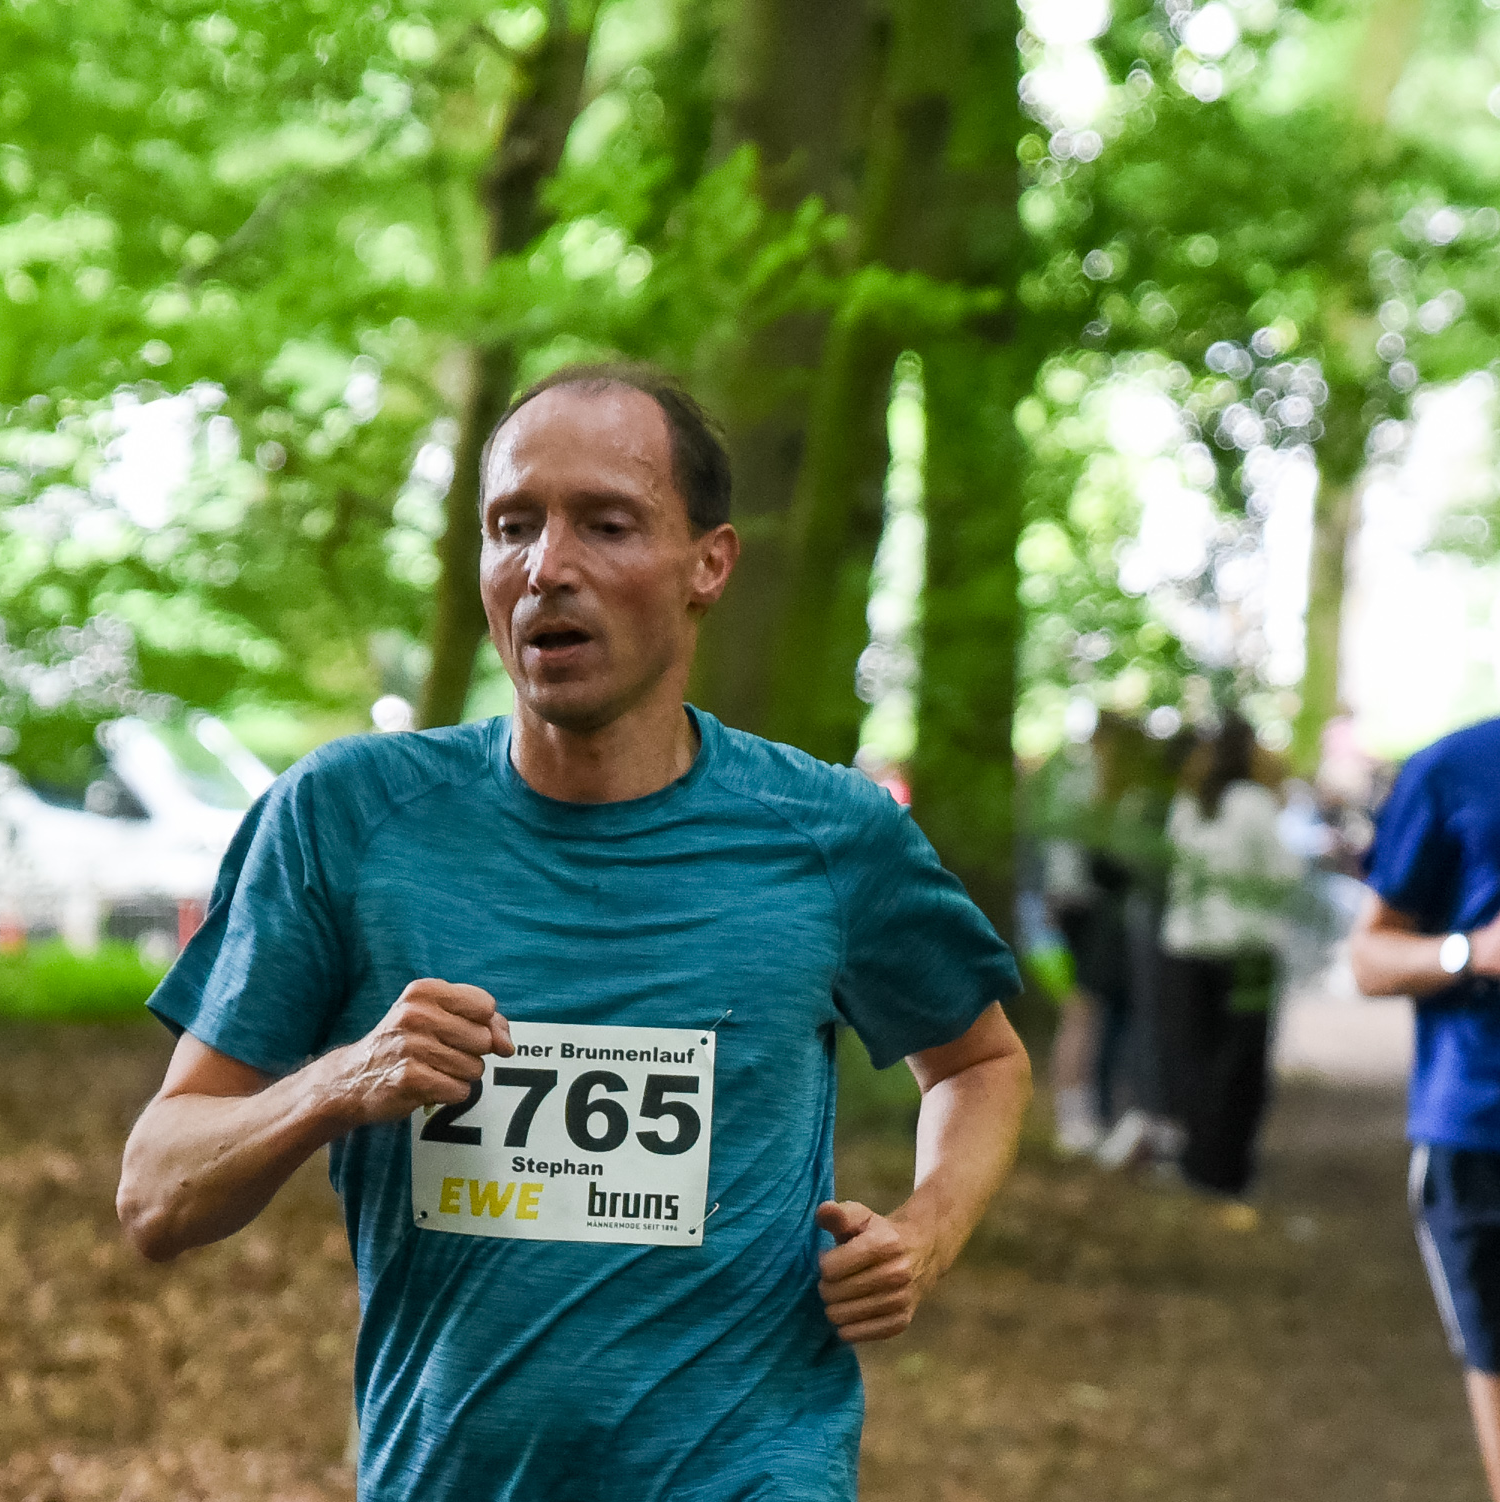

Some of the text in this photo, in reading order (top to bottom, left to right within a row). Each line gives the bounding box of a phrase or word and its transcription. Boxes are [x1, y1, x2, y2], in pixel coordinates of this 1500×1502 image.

[517, 1043, 695, 1063] ner Brunnenlauf
[419, 1067, 701, 1155] 2765
[511, 1156, 604, 1176] Stephan
[439, 1177, 544, 1220] EWE
[587, 1181, 679, 1220] bruns
[642, 1223, 660, 1231] SEIT
